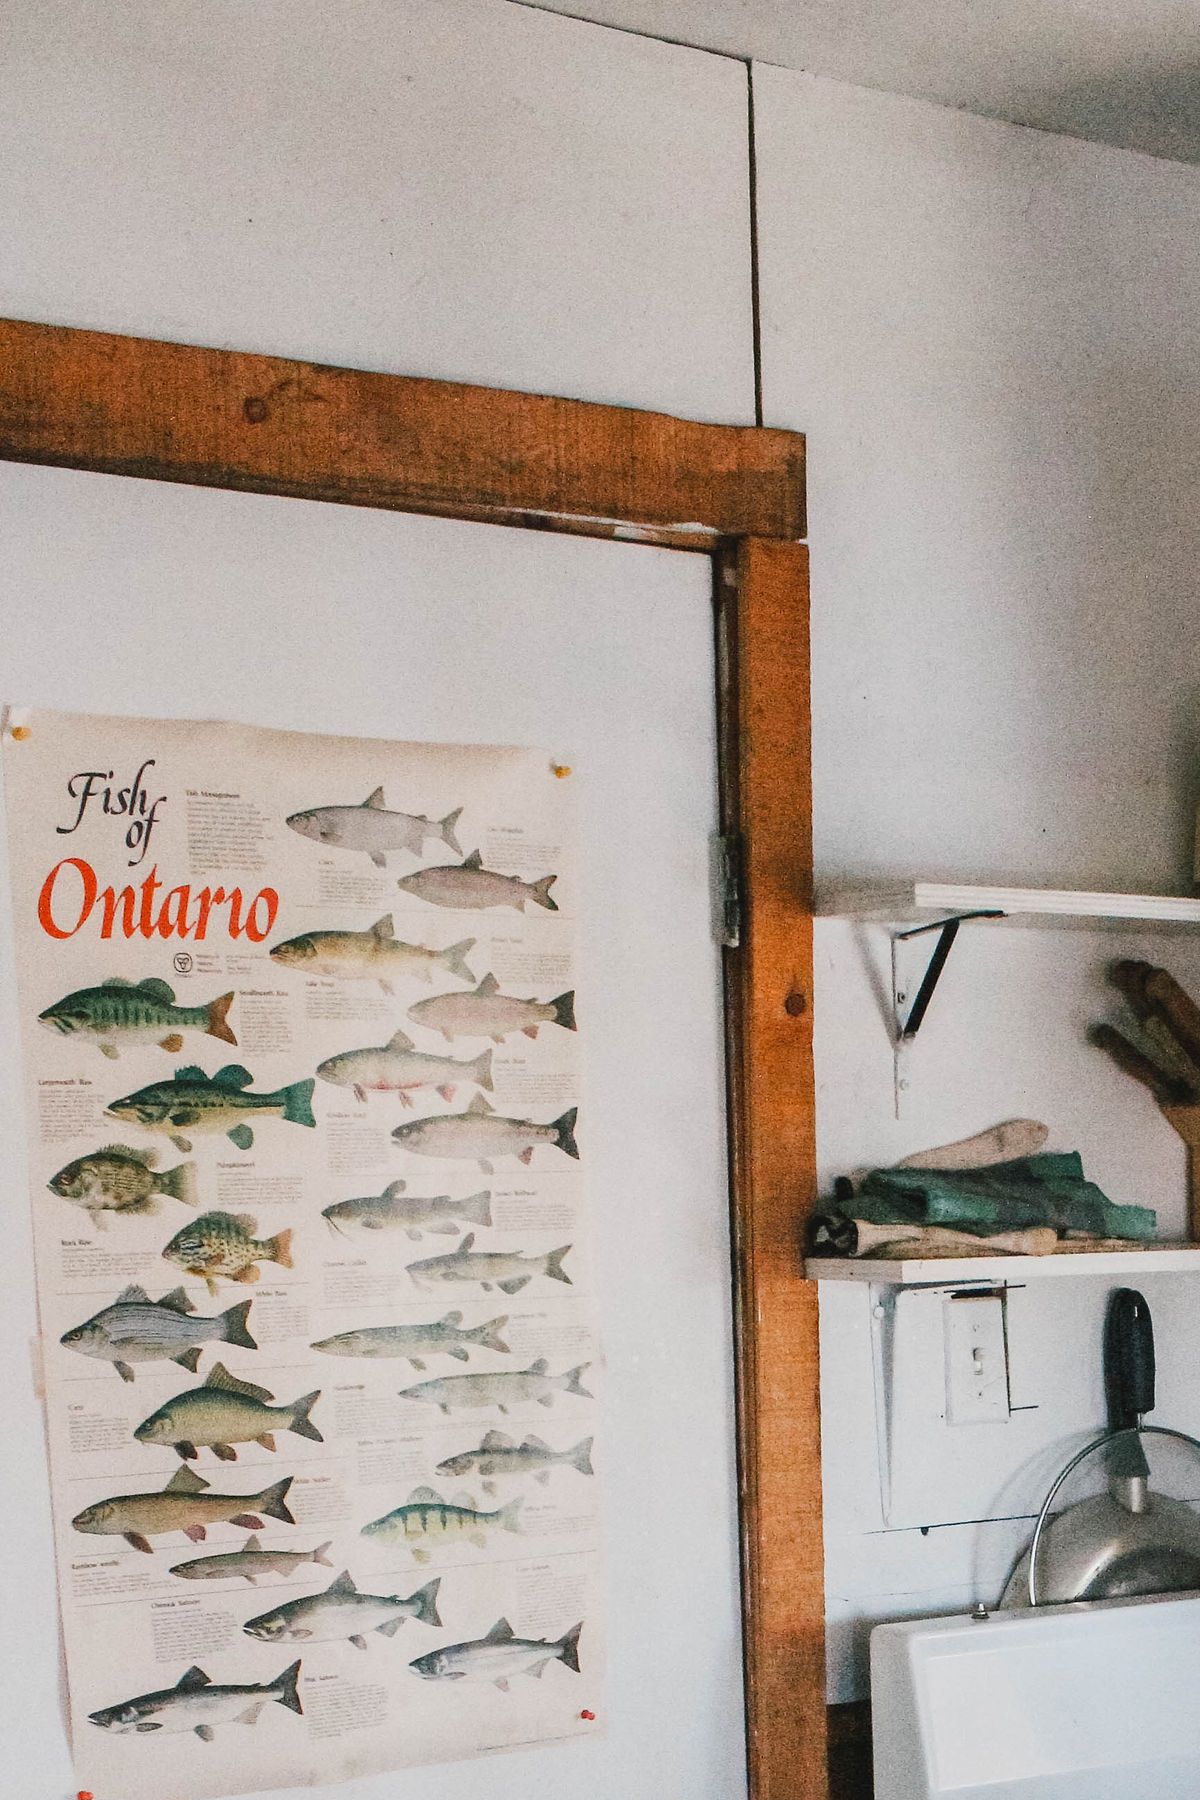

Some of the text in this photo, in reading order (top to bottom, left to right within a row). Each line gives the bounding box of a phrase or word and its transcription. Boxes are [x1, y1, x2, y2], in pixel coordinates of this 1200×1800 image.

[56, 759, 156, 834] Fish
[125, 796, 167, 867] of
[37, 857, 279, 943] Ontario
